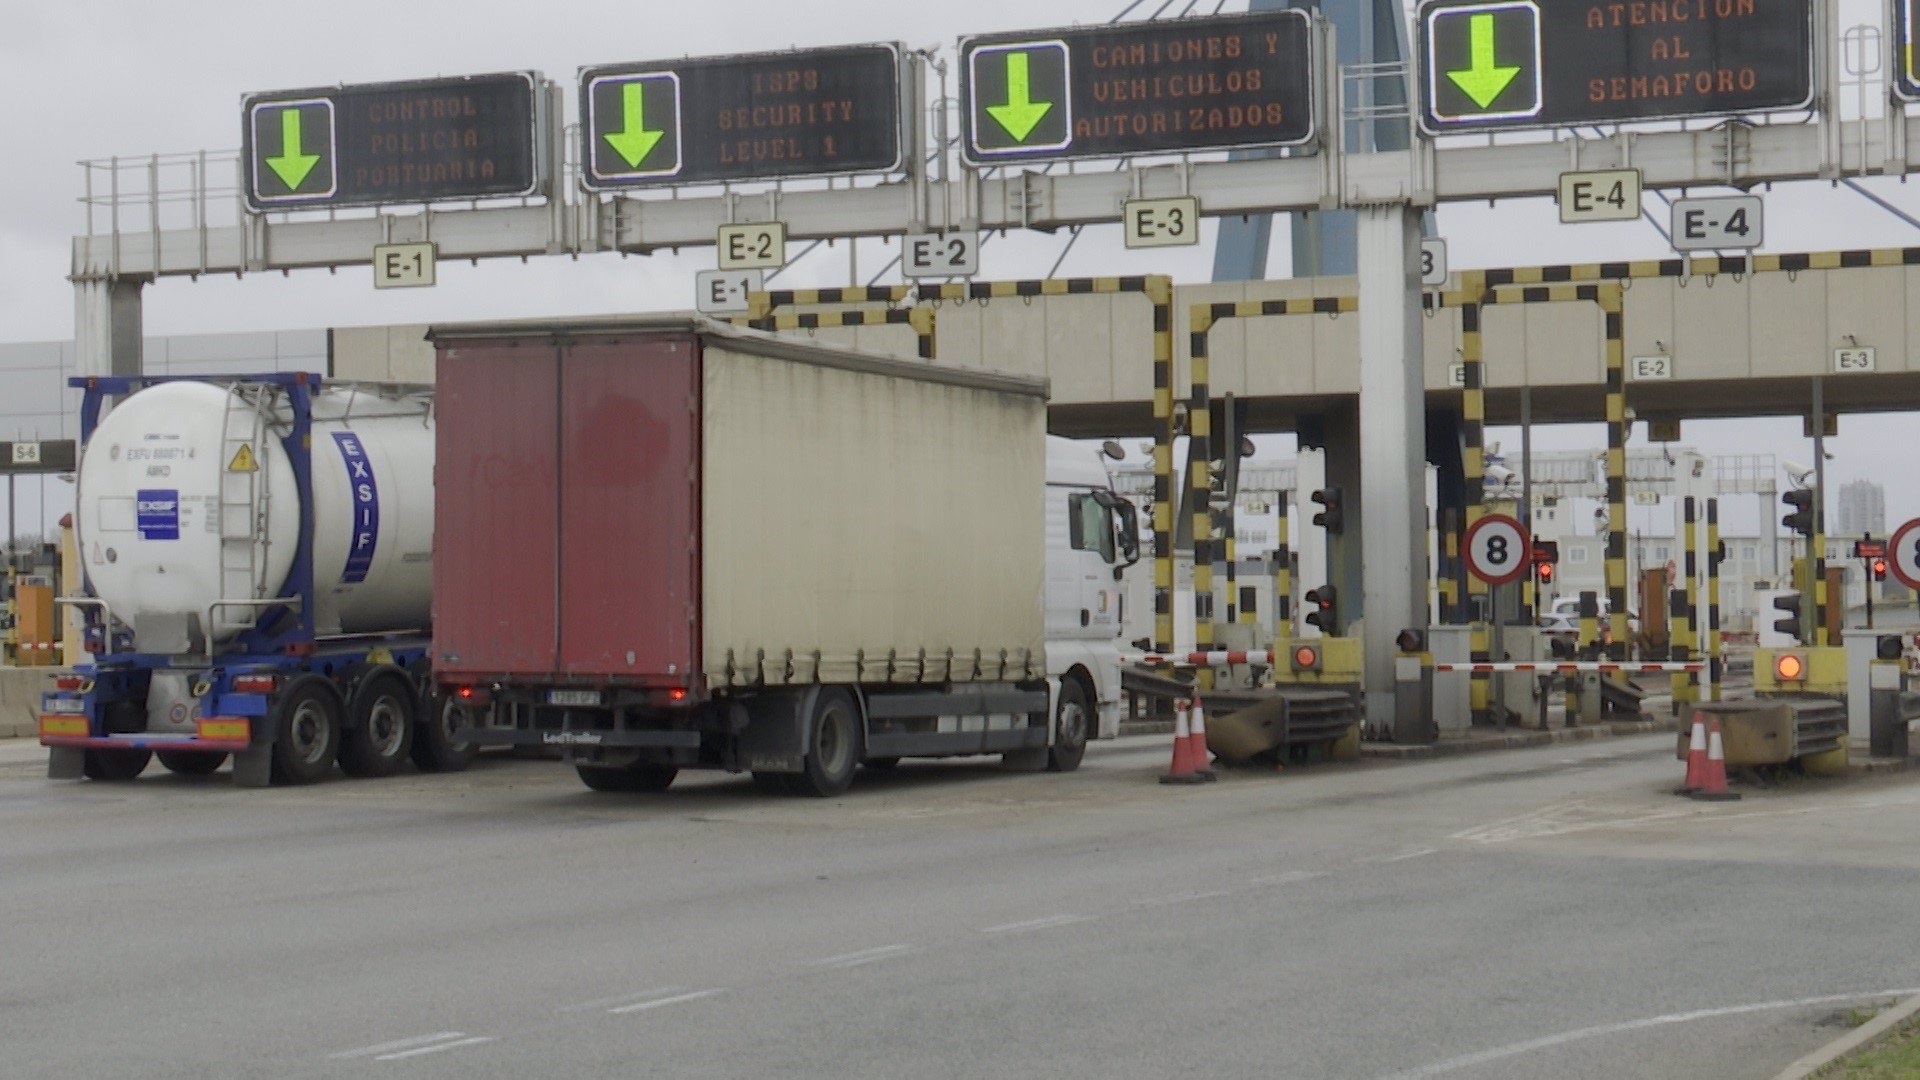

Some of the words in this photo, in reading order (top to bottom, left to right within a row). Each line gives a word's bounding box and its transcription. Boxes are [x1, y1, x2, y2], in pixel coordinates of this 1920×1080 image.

[1586, 0, 1755, 29] ATENCION
[1091, 34, 1241, 69] CAMIONES
[1266, 33, 1278, 55] Y
[1651, 36, 1690, 60] AL
[754, 69, 819, 94] ISPS
[1092, 68, 1262, 102] VEHICULOS
[1588, 68, 1756, 103] SEMAFORO
[369, 97, 477, 124] CONTROL
[718, 101, 853, 131] SECURITY
[1075, 102, 1282, 138] AUTORIZADOS
[370, 128, 479, 154] POLICIA
[719, 135, 803, 163] LEVEL
[823, 134, 837, 157] 1
[355, 159, 496, 188] PORTUARIA
[1573, 180, 1625, 212] E-4
[1137, 208, 1184, 238] E-3
[1685, 208, 1749, 239] E-4
[730, 233, 772, 260] E-2
[914, 240, 965, 267] E-2
[386, 252, 421, 279] E-1
[711, 278, 749, 303] E-1
[1638, 360, 1665, 376] E-2
[1840, 351, 1868, 368] E-3
[16, 445, 36, 460] S-6
[341, 439, 373, 550] EXSIF
[1486, 534, 1508, 565] 8
